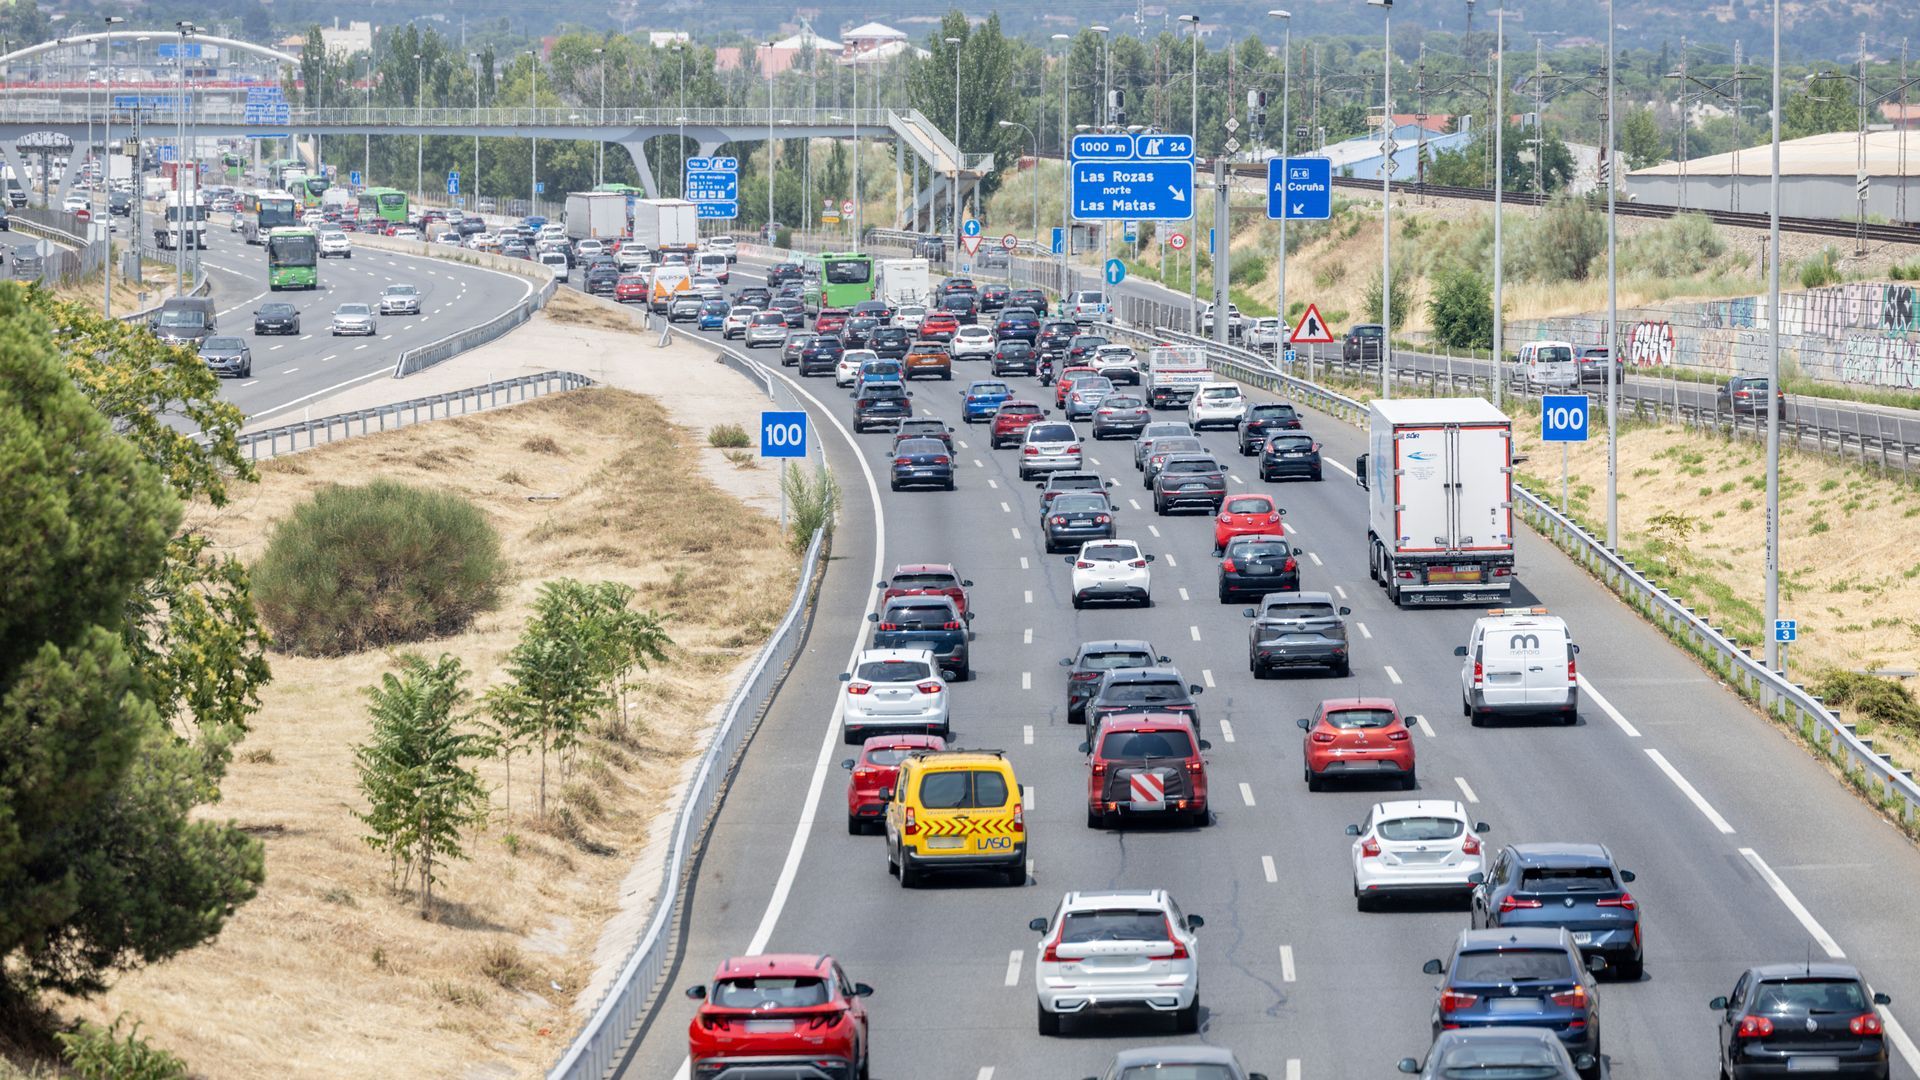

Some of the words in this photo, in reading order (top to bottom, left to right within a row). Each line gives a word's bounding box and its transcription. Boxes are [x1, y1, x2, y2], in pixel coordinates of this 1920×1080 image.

[1081, 142, 1108, 152] 1000
[1115, 144, 1127, 152] m
[1170, 142, 1186, 152] 24
[1081, 171, 1106, 183] Las
[1113, 171, 1154, 183] Rozas
[1103, 186, 1132, 195] norte
[1275, 183, 1282, 192] A
[1288, 181, 1325, 192] Coruña
[1081, 200, 1105, 212] Las
[1113, 200, 1156, 212] Matas
[1547, 407, 1583, 430] 100
[765, 423, 803, 446] 100
[1780, 621, 1791, 629] 23
[1782, 630, 1790, 640] 3
[977, 836, 1012, 850] LASO
